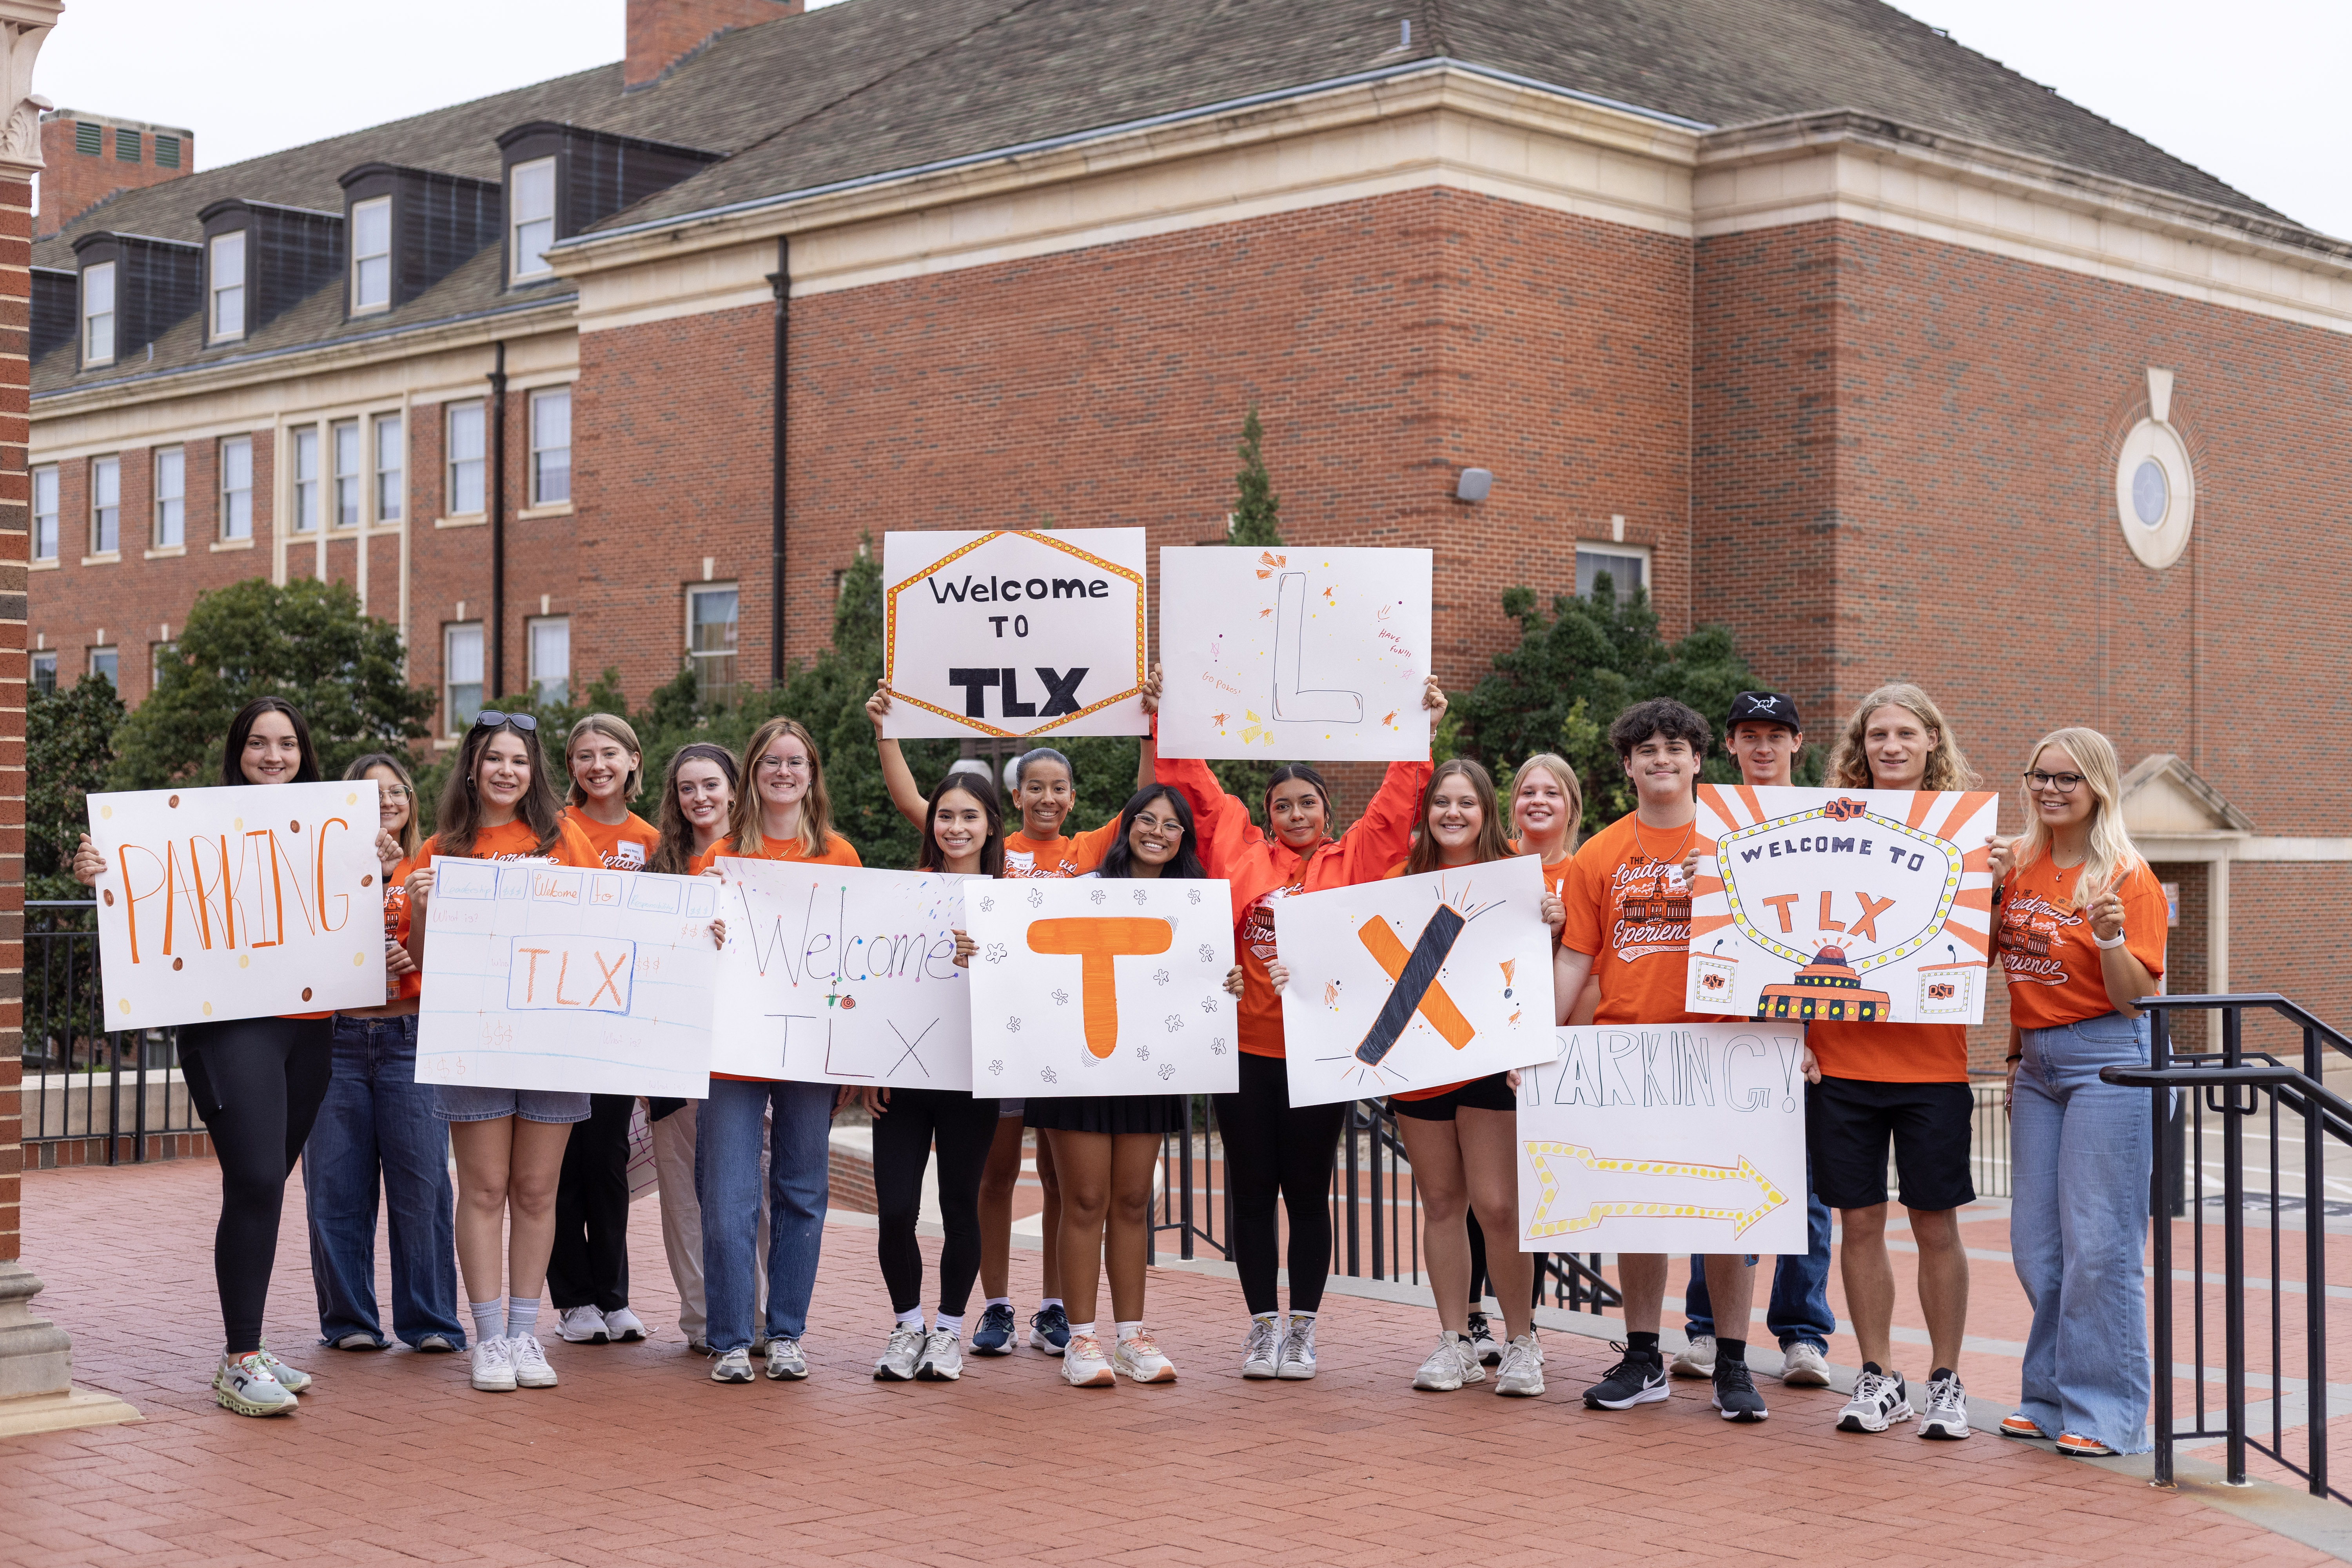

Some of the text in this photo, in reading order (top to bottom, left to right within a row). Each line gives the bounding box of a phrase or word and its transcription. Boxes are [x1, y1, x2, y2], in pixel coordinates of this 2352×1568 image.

[928, 575, 1109, 604] Welcome
[989, 615, 1029, 637] TO
[1378, 628, 1401, 642] HAVE
[1273, 572, 1363, 723] L
[1390, 645, 1411, 659] FUN!!!
[949, 668, 1090, 718] TLX
[1824, 797, 1867, 822] OSU
[1630, 857, 1644, 865] THE
[1741, 836, 1925, 872] WELCOME TO
[119, 818, 348, 964] PARKING
[443, 875, 492, 898] Leadership
[534, 874, 578, 898] Welcome
[592, 877, 614, 903] to
[433, 907, 479, 923] What is?
[1762, 891, 1896, 944] TLX
[737, 880, 959, 987] Welcome
[1621, 946, 1650, 960] OKLAHOMA
[518, 949, 626, 1007] TLX
[1027, 917, 1172, 1059] T
[1355, 904, 1475, 1066] X
[1702, 974, 1725, 990] OSU
[1928, 983, 1955, 1000] OSU
[764, 1014, 940, 1078] TLX
